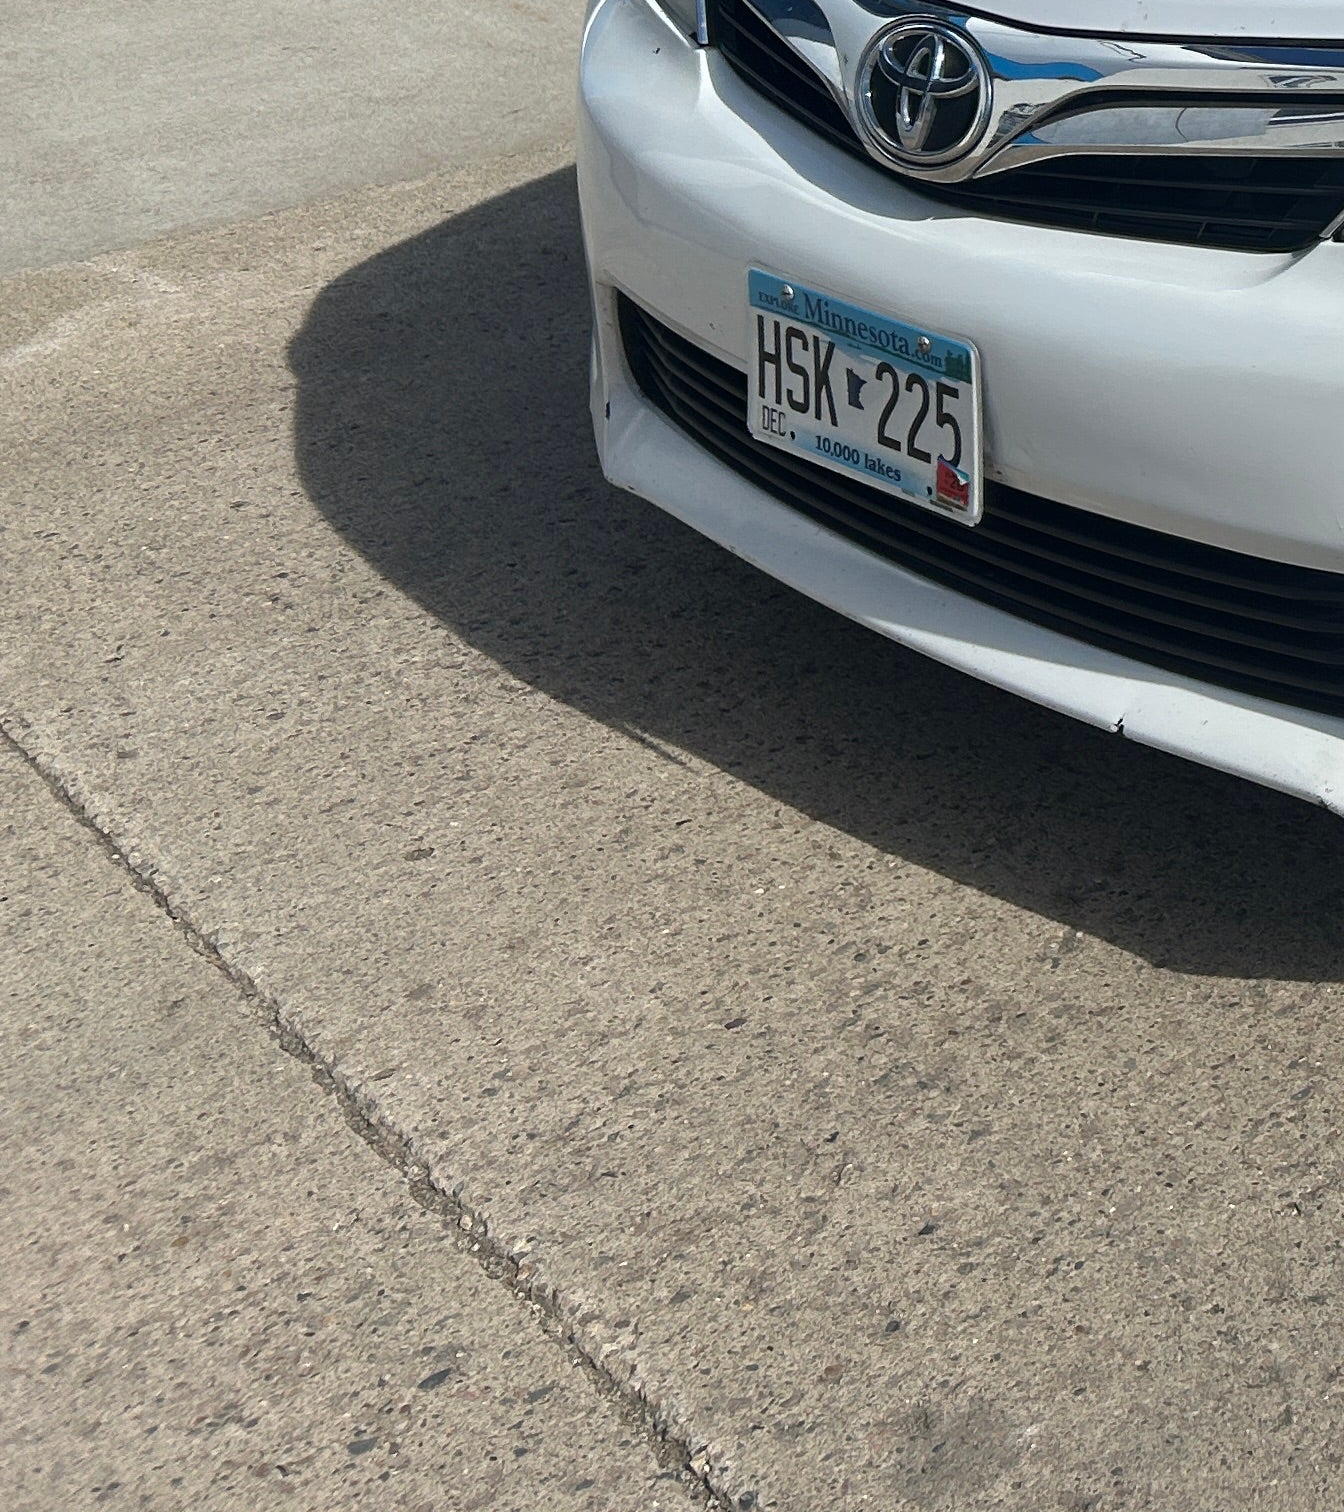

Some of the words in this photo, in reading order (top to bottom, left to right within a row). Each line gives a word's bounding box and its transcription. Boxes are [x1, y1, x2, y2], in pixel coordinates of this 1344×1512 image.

[756, 314, 839, 428] HSK
[875, 361, 962, 468] 225
[761, 405, 787, 437] DEC
[814, 434, 861, 465] 10,000
[864, 453, 902, 483] lakes
